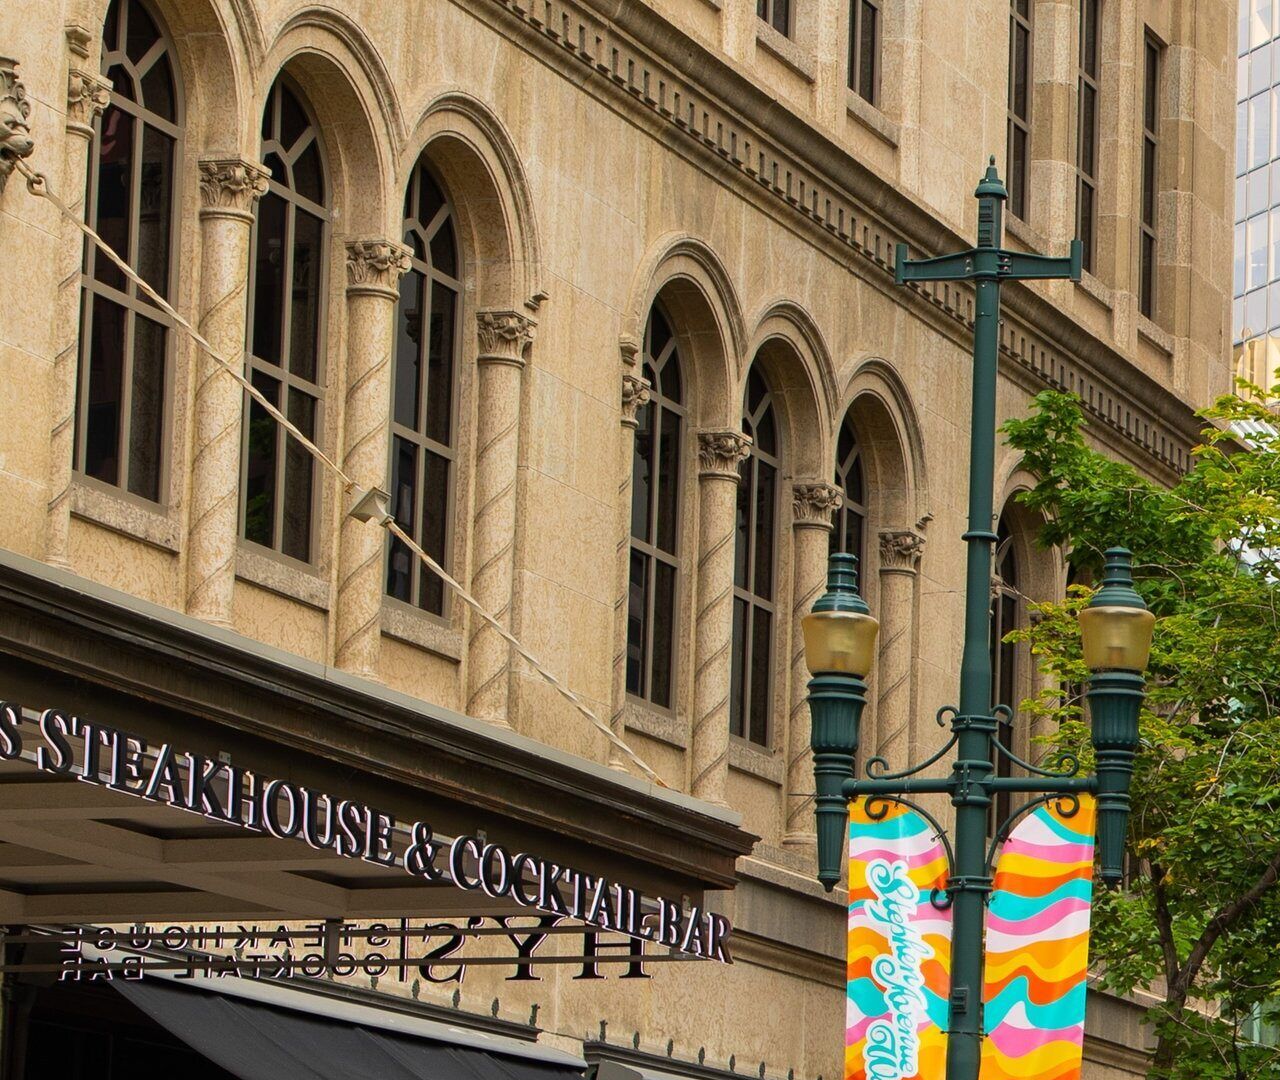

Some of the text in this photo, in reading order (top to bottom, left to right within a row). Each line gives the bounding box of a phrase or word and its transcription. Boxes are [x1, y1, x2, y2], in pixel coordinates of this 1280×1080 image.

[37, 708, 396, 868] STEAKHOUSE
[403, 821, 443, 880] &
[449, 834, 654, 941] COCKTAIL
[656, 896, 734, 965] BAR
